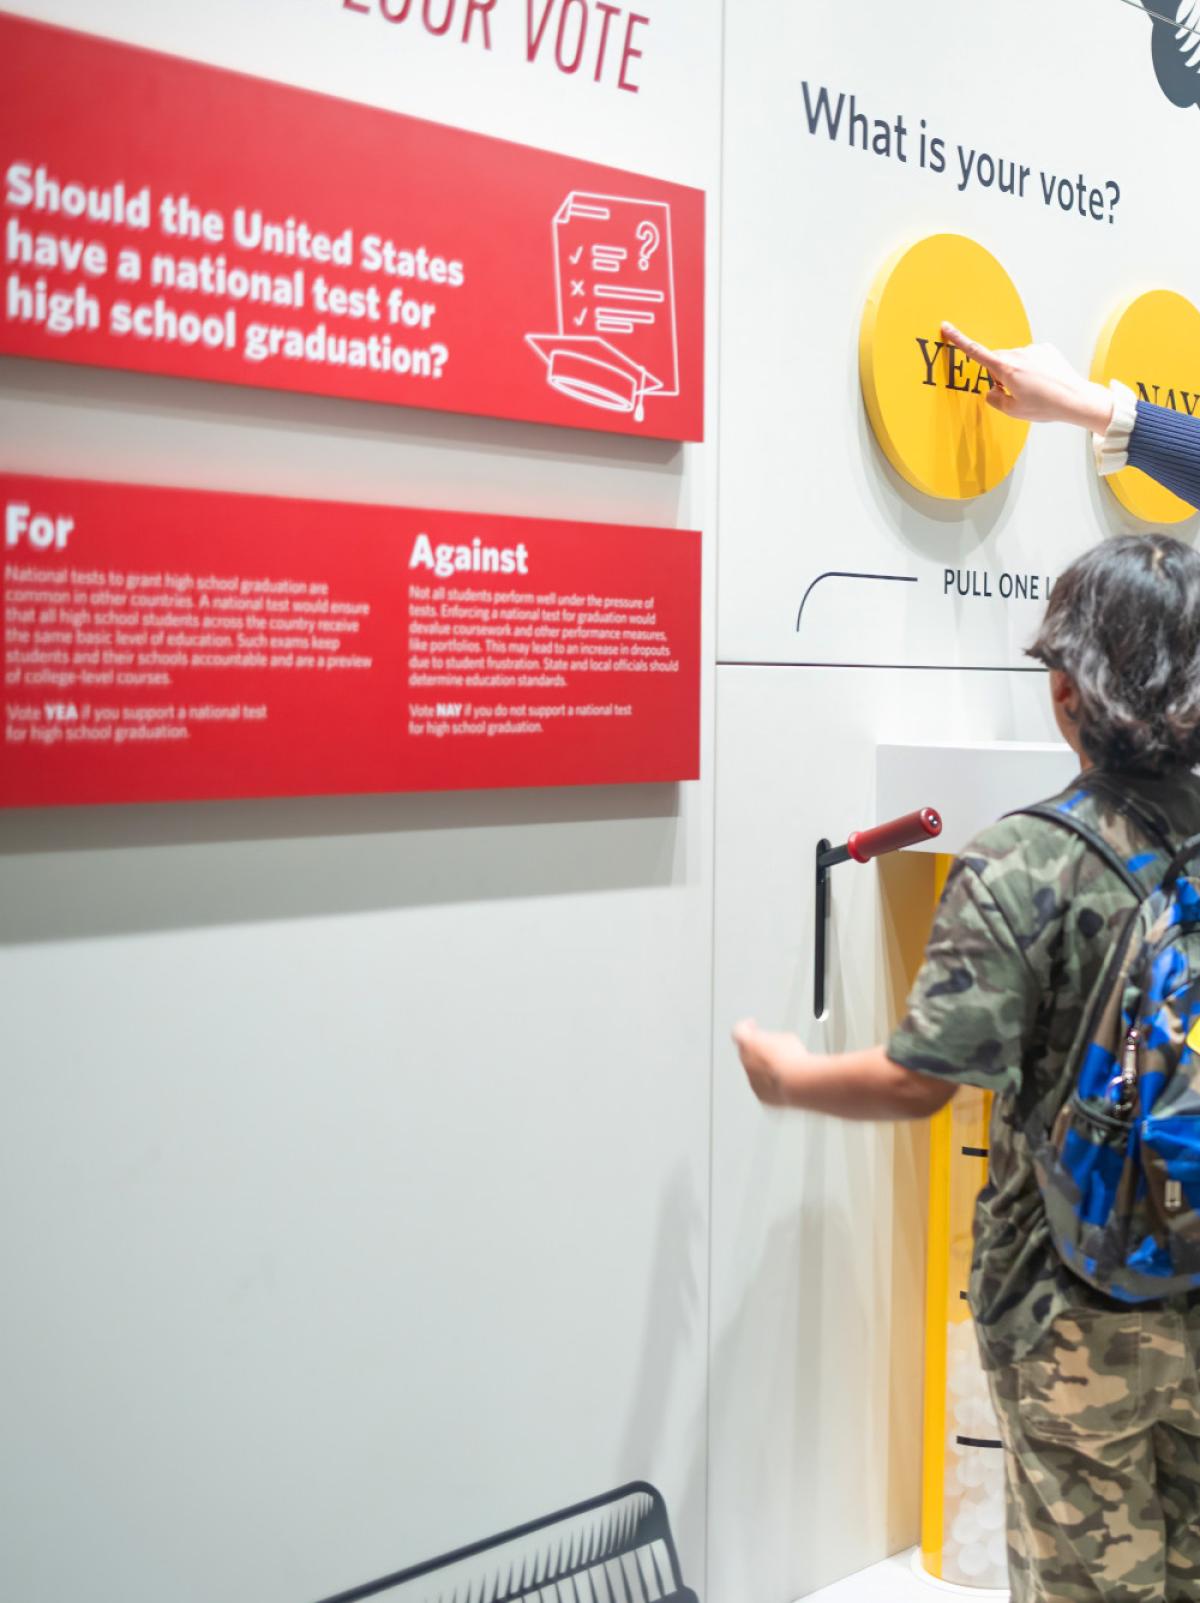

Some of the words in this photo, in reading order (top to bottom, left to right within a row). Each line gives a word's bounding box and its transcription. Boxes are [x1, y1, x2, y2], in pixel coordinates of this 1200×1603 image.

[525, 0, 649, 93] VOTE
[801, 81, 907, 162] What
[920, 120, 945, 173] is
[957, 145, 1030, 197] your
[1040, 172, 1120, 224] vote?
[6, 163, 151, 229] Should
[159, 196, 224, 242] the
[233, 207, 352, 266] United
[361, 235, 464, 286] States
[6, 218, 107, 275] have
[117, 249, 141, 281] a
[151, 255, 304, 307] national
[312, 276, 380, 321] test
[388, 288, 435, 329] for
[6, 273, 100, 334] high
[110, 297, 236, 349] school
[244, 323, 449, 378] graduation?
[5, 503, 74, 548] For
[409, 533, 528, 577] Against
[944, 569, 992, 596] PULL
[1000, 573, 1039, 600] ONE
[44, 705, 78, 720] YEA
[409, 704, 433, 717] Vote
[436, 704, 462, 717] NAY
[464, 704, 472, 717] if
[473, 707, 493, 721] you
[494, 704, 508, 717] do
[510, 705, 526, 717] not
[528, 705, 566, 720] support
[568, 707, 574, 716] a
[575, 703, 613, 716] national
[614, 704, 632, 716] test
[409, 721, 424, 734] for
[426, 721, 449, 738] high
[452, 720, 486, 734] school
